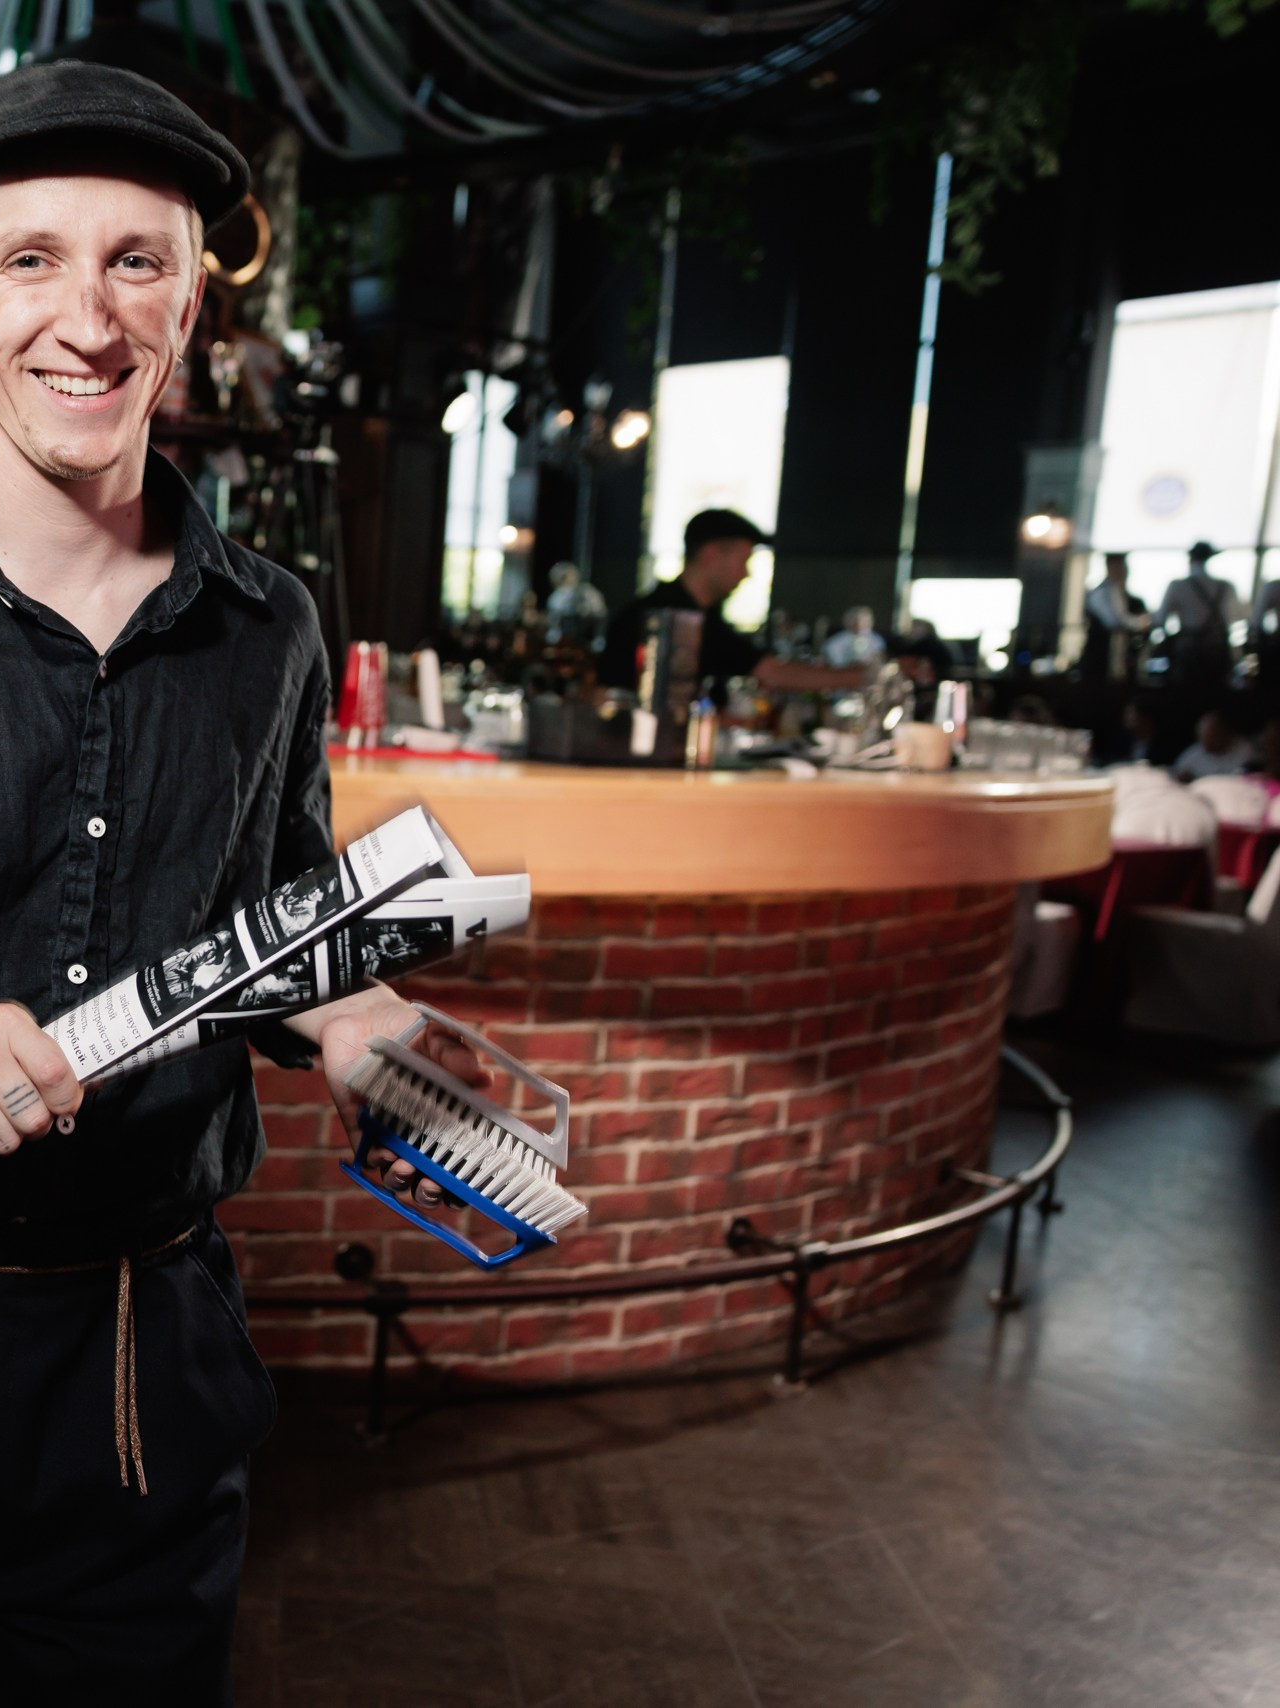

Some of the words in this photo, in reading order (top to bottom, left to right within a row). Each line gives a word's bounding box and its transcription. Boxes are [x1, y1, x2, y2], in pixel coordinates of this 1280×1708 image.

[66, 1027, 88, 1066] рублей.
[119, 1036, 129, 1049] за
[89, 1043, 104, 1064] вам
